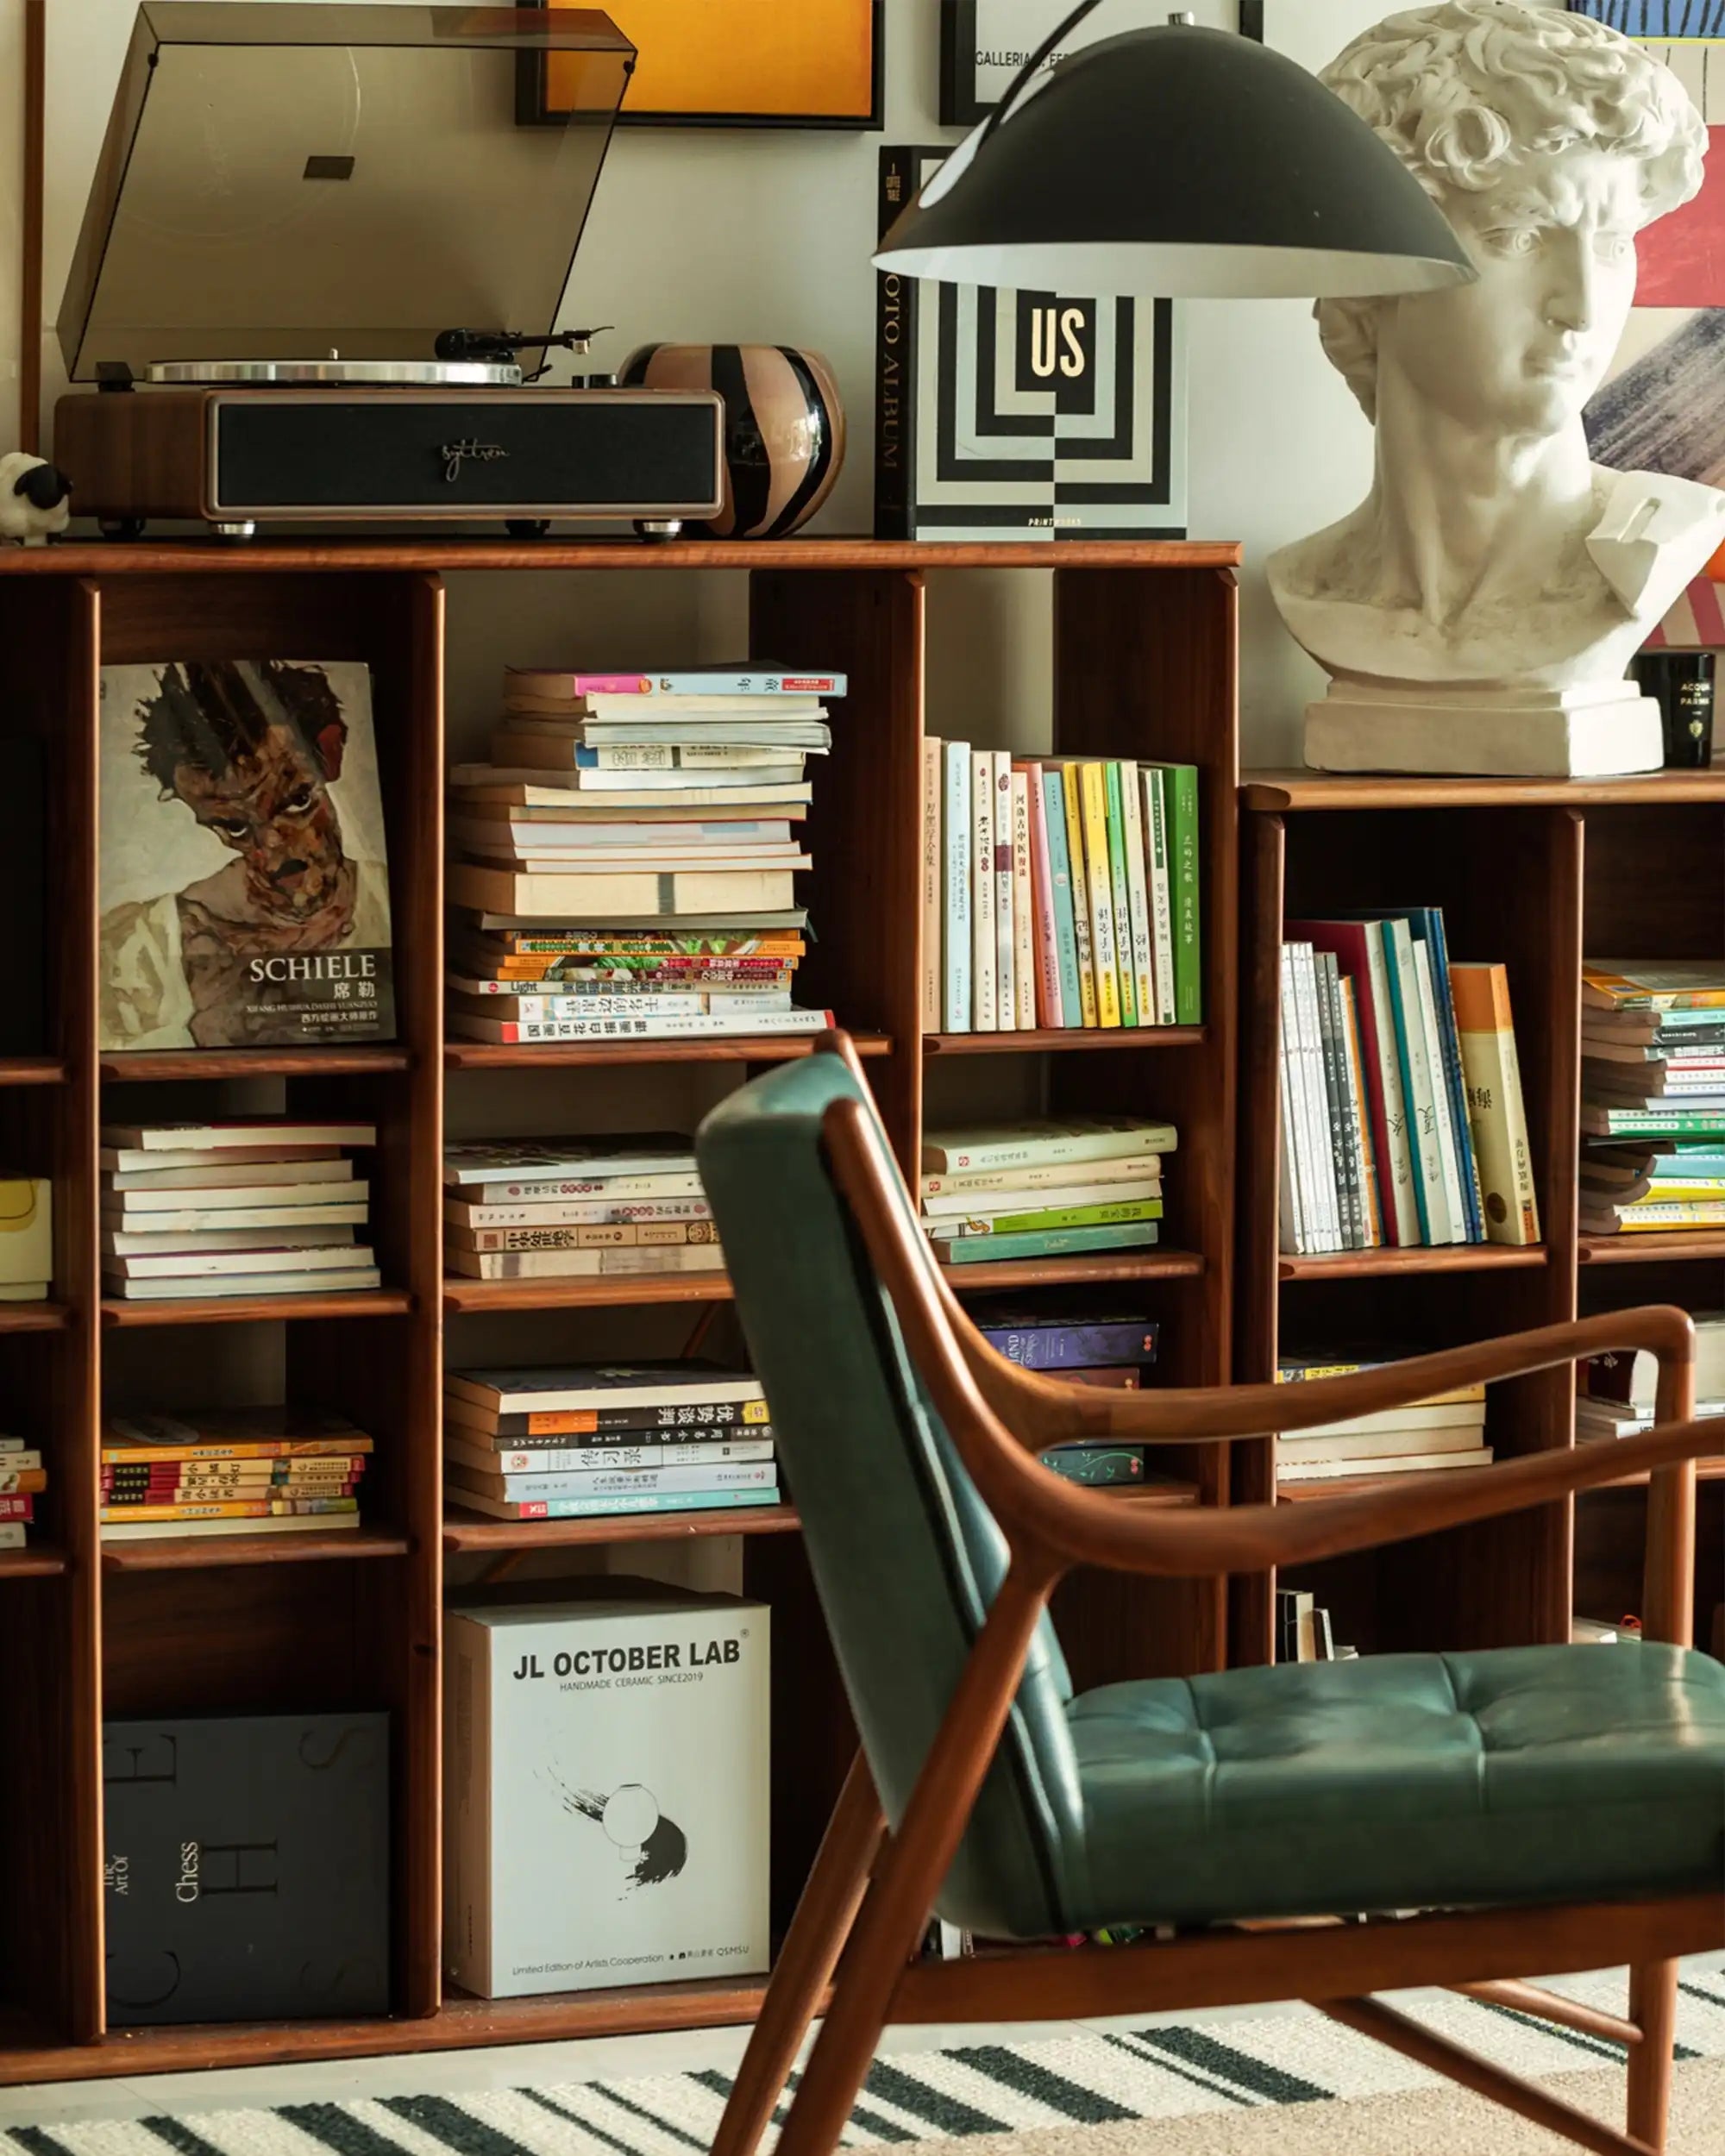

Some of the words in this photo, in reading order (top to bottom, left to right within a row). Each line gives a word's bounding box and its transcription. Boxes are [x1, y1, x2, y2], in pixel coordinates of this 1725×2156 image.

[883, 273, 900, 345] OTO
[1032, 308, 1085, 378] US
[882, 351, 899, 468] ALBUM
[249, 954, 377, 982] SCHIELE
[333, 981, 375, 1000] 席勒
[511, 981, 538, 993] Light
[508, 1229, 575, 1249] 中华处世绝学
[658, 1405, 735, 1426] 优势谈判
[660, 1428, 724, 1442] 周易全书
[580, 1448, 643, 1467] 传习录
[513, 1654, 545, 1680] JL
[553, 1644, 681, 1677] OCTOBER
[689, 1639, 741, 1666] LAB
[560, 1678, 612, 1692] HANDMADE
[615, 1676, 654, 1689] CERAMIC
[112, 1854, 129, 1874] Of
[175, 1841, 199, 1903] Chess
[115, 1877, 129, 1896] Art
[512, 1964, 543, 1976] Limited
[544, 1962, 574, 1974] Edition
[574, 1960, 584, 1971] of
[609, 1952, 664, 1967] Cooperation
